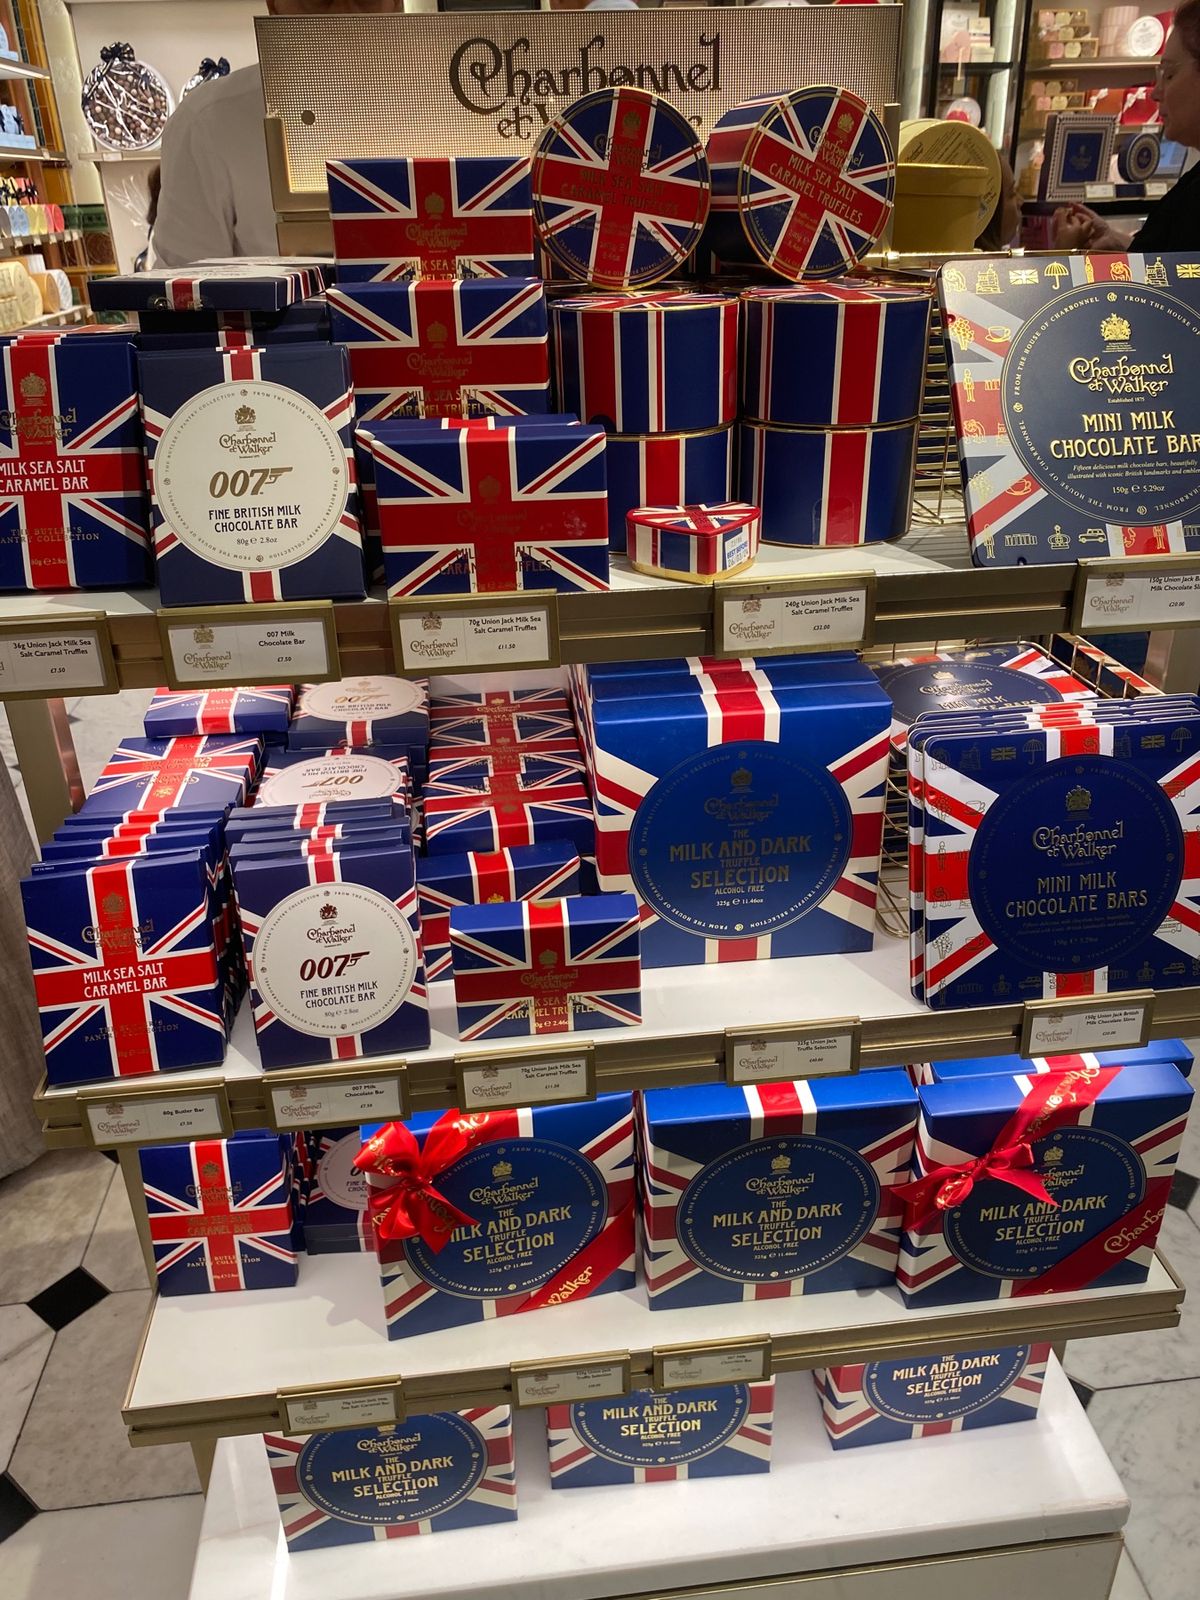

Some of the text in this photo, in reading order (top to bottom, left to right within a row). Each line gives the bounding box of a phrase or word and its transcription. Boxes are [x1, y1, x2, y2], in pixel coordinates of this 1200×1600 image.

[449, 33, 722, 115] Charbonnel
[497, 106, 533, 140] et
[787, 154, 858, 202] MILK SEA SALT
[769, 163, 863, 225] CARAMEL TRUFFLES
[1068, 354, 1174, 384] Charbonnel
[1088, 376, 1168, 397] et Walker
[392, 404, 440, 417] CARAMEL
[1082, 411, 1176, 433] MINI MILK
[219, 432, 277, 449] Charbonnel
[237, 445, 273, 455] Walker
[1050, 434, 1200, 459] CHOCOLATE BAR
[30, 461, 54, 475] SEA
[57, 460, 85, 474] SALT
[63, 477, 89, 490] BAR
[209, 468, 270, 498] 007
[1113, 486, 1129, 494] 150g
[209, 505, 301, 520] FINE BRITISH MILK
[214, 518, 298, 533] CHOCOLATE BAR
[733, 829, 750, 839] THE
[1032, 820, 1124, 851] Charbonnel
[669, 835, 813, 862] MILK AND DARK
[1047, 843, 1117, 860] et Walker
[720, 857, 761, 867] TRUFFLE
[690, 865, 790, 889] SELECTION
[1038, 871, 1117, 894] MINI MILK
[714, 886, 745, 894] ALCOHOL
[1005, 889, 1148, 919] CHOCOLATE BARS
[307, 924, 356, 941] Charbonnel
[323, 935, 353, 944] Walker
[83, 962, 164, 984] MILK SEA SALT
[300, 954, 350, 981] 007
[84, 976, 167, 998] CARAMEL BAR
[300, 981, 378, 999] FINE BRITISH MILK
[306, 992, 376, 1009] CHOCOLATE BAR
[469, 1177, 539, 1203] Charbonnel
[746, 1173, 815, 1193] Charbonnel
[766, 1185, 809, 1196] Walker
[490, 1190, 534, 1207] Walker
[979, 1203, 1018, 1222] MILK
[1061, 1195, 1109, 1213] DARK
[487, 1216, 521, 1235] AND
[525, 1205, 572, 1228] DARK
[498, 1209, 514, 1217] THE
[713, 1203, 843, 1229] MILK AND DARK
[1024, 1213, 1060, 1224] TRUFFLE
[490, 1229, 527, 1242] TRUFFLE
[759, 1221, 796, 1231] TRUFFLE
[994, 1219, 1086, 1242] SELECTION
[731, 1226, 822, 1248] SELECTION
[753, 1242, 782, 1251] ALCOHOL
[463, 1232, 555, 1263] SELECTION
[486, 1251, 533, 1264] ALCOHOL FREE
[547, 1266, 593, 1306] Walker
[892, 1354, 1001, 1381] MILK AND DARK
[930, 1370, 961, 1381] TRUFFLE
[906, 1373, 983, 1396] SELECTION
[602, 1400, 718, 1420] MILK AND DARK
[644, 1415, 677, 1423] TRUFFLE
[620, 1419, 702, 1436] SELECTION
[357, 1433, 422, 1451] Charbonnel
[331, 1455, 454, 1483] MILK AND DARK
[384, 1456, 400, 1464] THE
[353, 1475, 439, 1498] SELECTION
[377, 1472, 412, 1483] TRUFFLE
